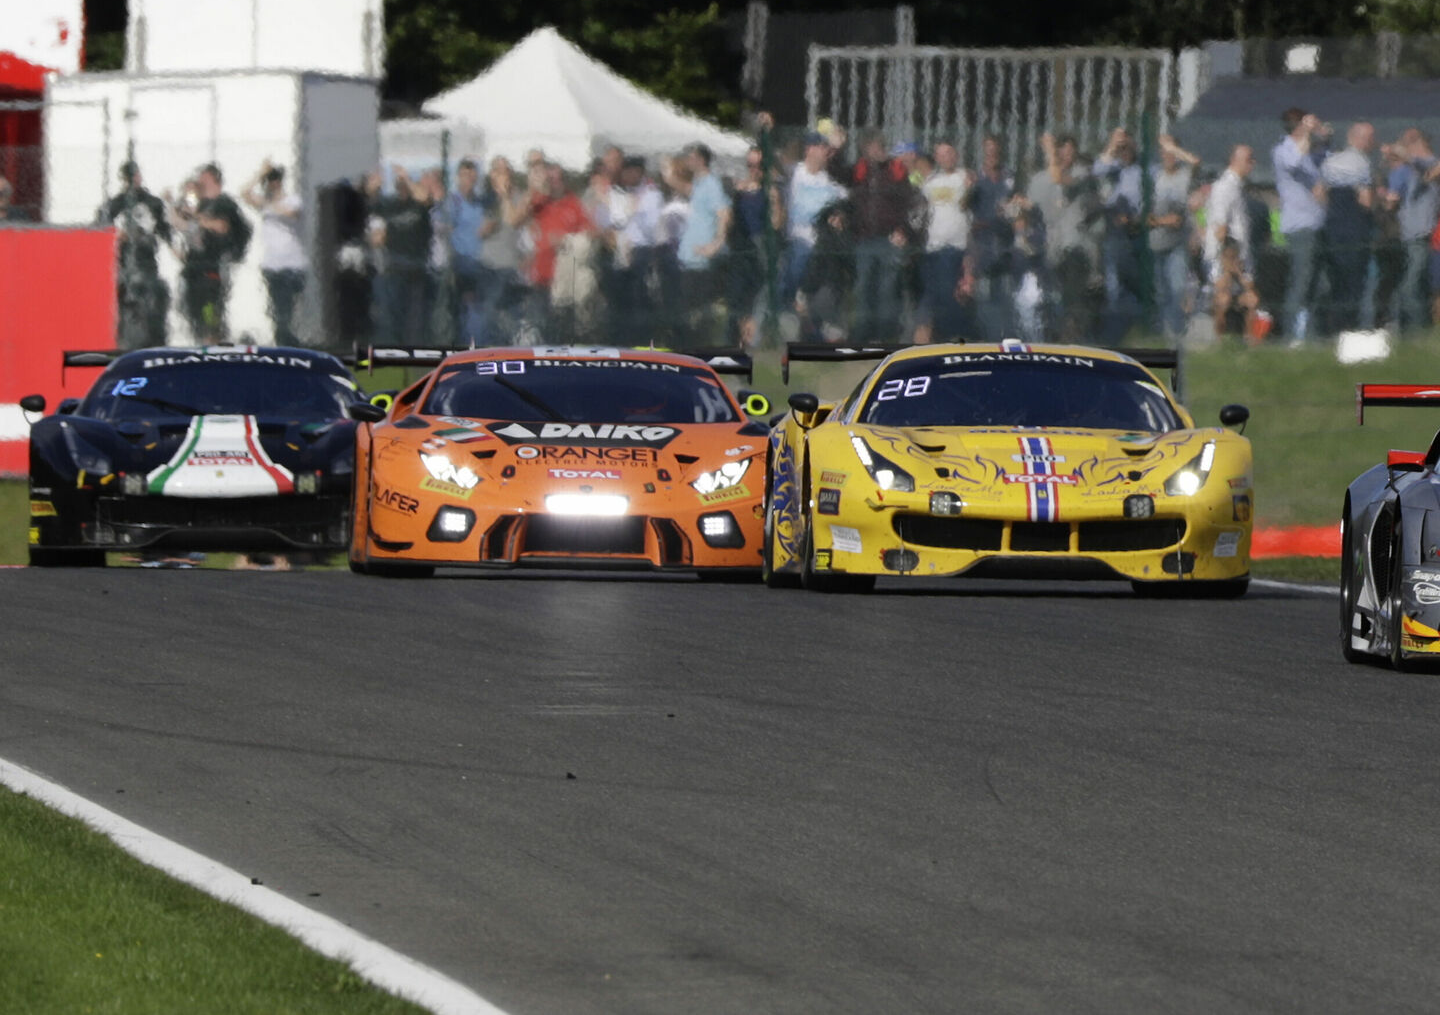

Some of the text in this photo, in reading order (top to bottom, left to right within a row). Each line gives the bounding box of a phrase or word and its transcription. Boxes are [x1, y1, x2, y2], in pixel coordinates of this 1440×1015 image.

[143, 354, 312, 369] BLANCPAIN
[533, 359, 681, 373] BLANCPAIN
[943, 354, 1095, 368] BLANCPAIN
[111, 376, 149, 397] 12
[877, 375, 931, 401] 28
[540, 422, 675, 441] DAIKO
[595, 459, 660, 468] MOTORS
[1021, 454, 1057, 463] PRO
[549, 469, 620, 479] TOTAL
[1003, 474, 1077, 485] TOTAL
